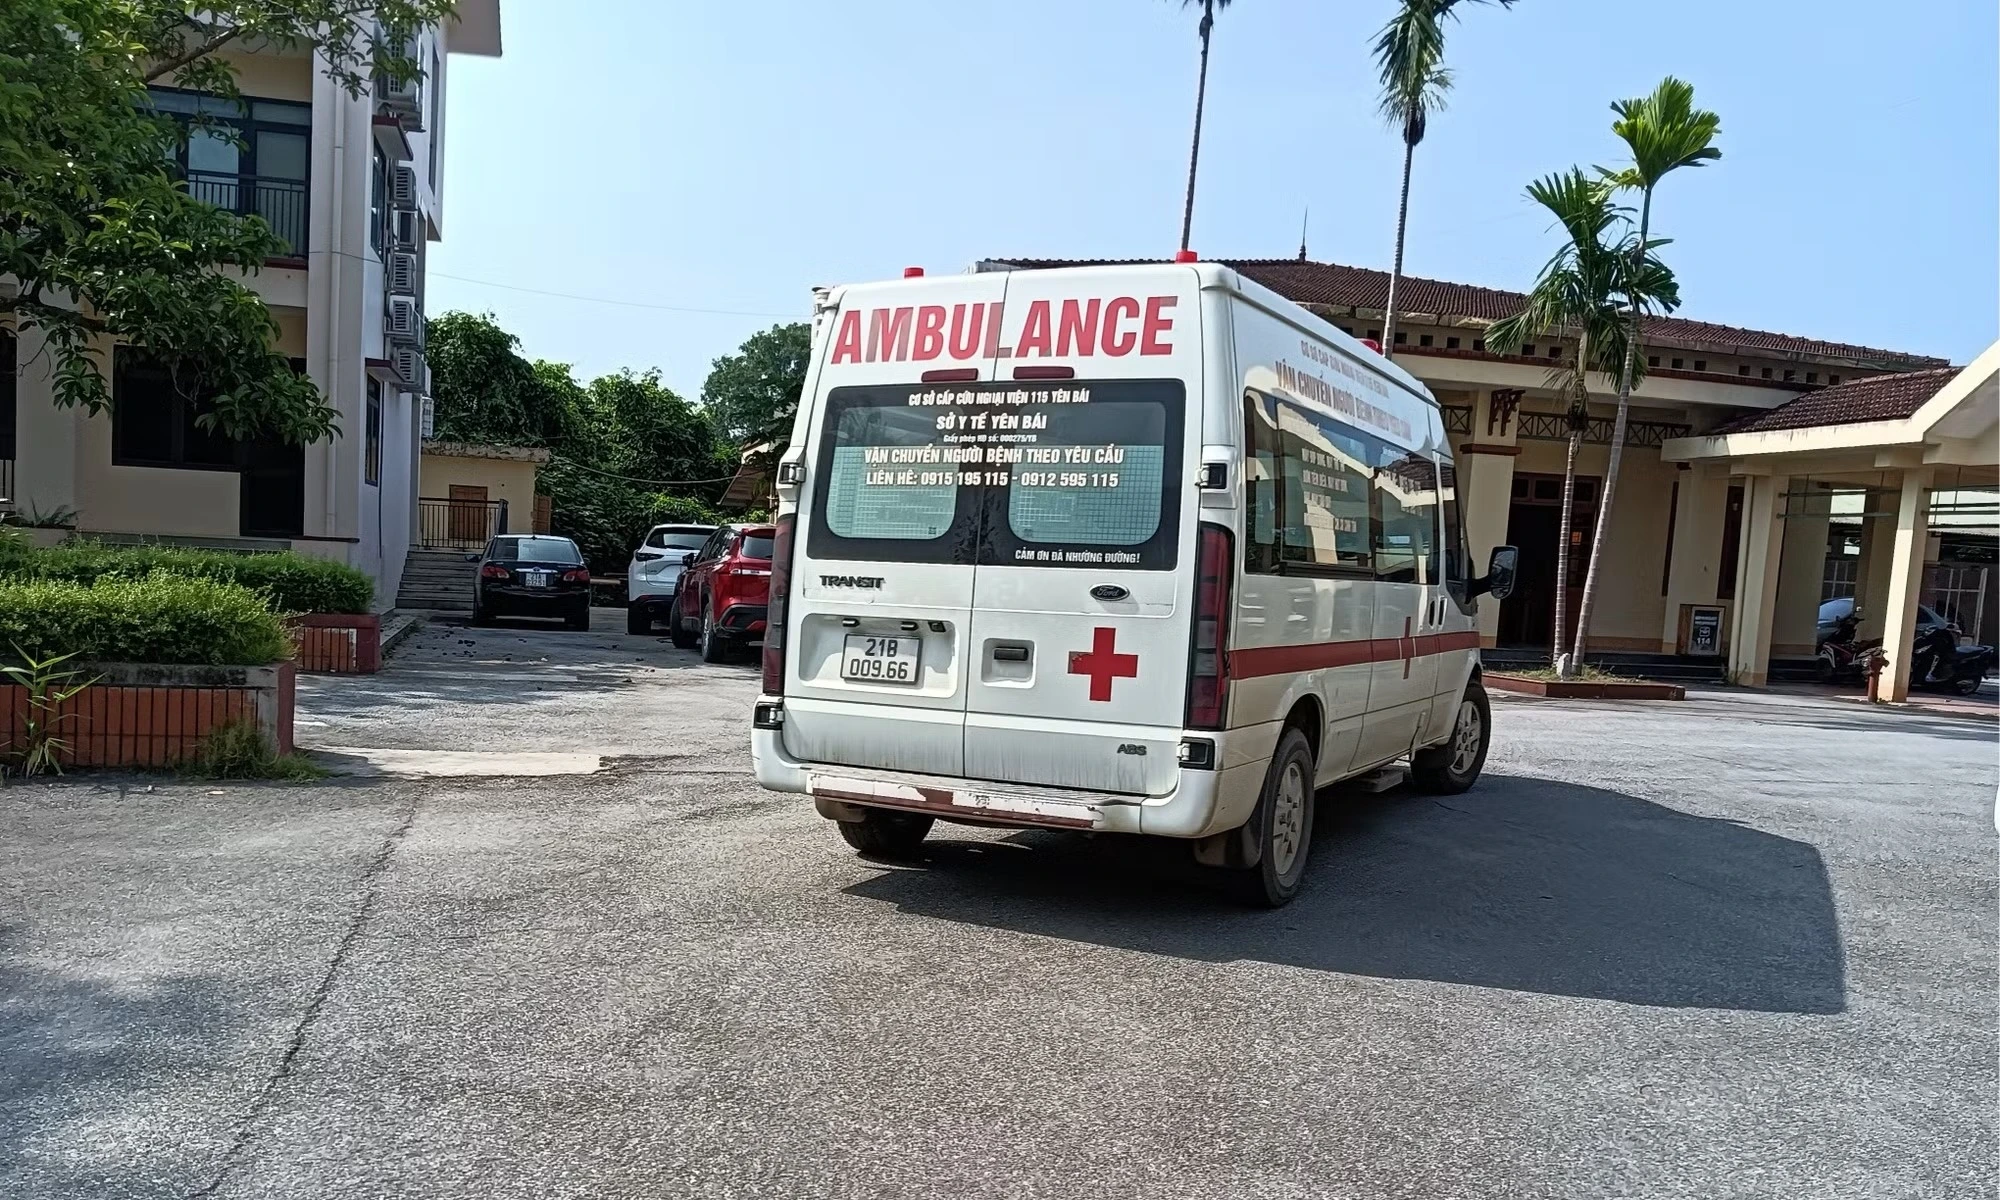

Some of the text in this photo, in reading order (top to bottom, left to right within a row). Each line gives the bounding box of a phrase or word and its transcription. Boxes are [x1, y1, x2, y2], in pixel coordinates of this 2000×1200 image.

[831, 296, 1178, 365] AMBULANCE
[908, 392, 922, 406] CƠ
[922, 389, 936, 406] SỞ
[936, 389, 955, 405] CẤP
[956, 390, 975, 405] CỨU
[1006, 389, 1029, 406] VIỆN
[1031, 391, 1049, 403] 115
[1051, 388, 1071, 403] YÊN
[1072, 387, 1090, 403] BÁI
[936, 411, 1048, 430] SỞ Y TẾ YÊN BÁI
[864, 443, 1125, 467] VẬN CHUYỂN NGƯỜI BỆNH THEO YÊU CẦU
[866, 469, 894, 485] LIÊN
[921, 472, 953, 486] 0915
[957, 472, 981, 485] 195
[984, 472, 1009, 486] 115
[1021, 472, 1056, 486] 0912
[1060, 473, 1087, 487] 595
[1091, 473, 1119, 487] 115
[1015, 546, 1141, 563] CẢM ƠN ĐÃ NHƯỜNG ĐƯỜNG!
[819, 575, 885, 589] TRANSIT
[1096, 586, 1120, 598] Ford
[865, 639, 898, 657] 21B
[850, 659, 908, 679] 009.66
[1117, 744, 1147, 756] ABS
